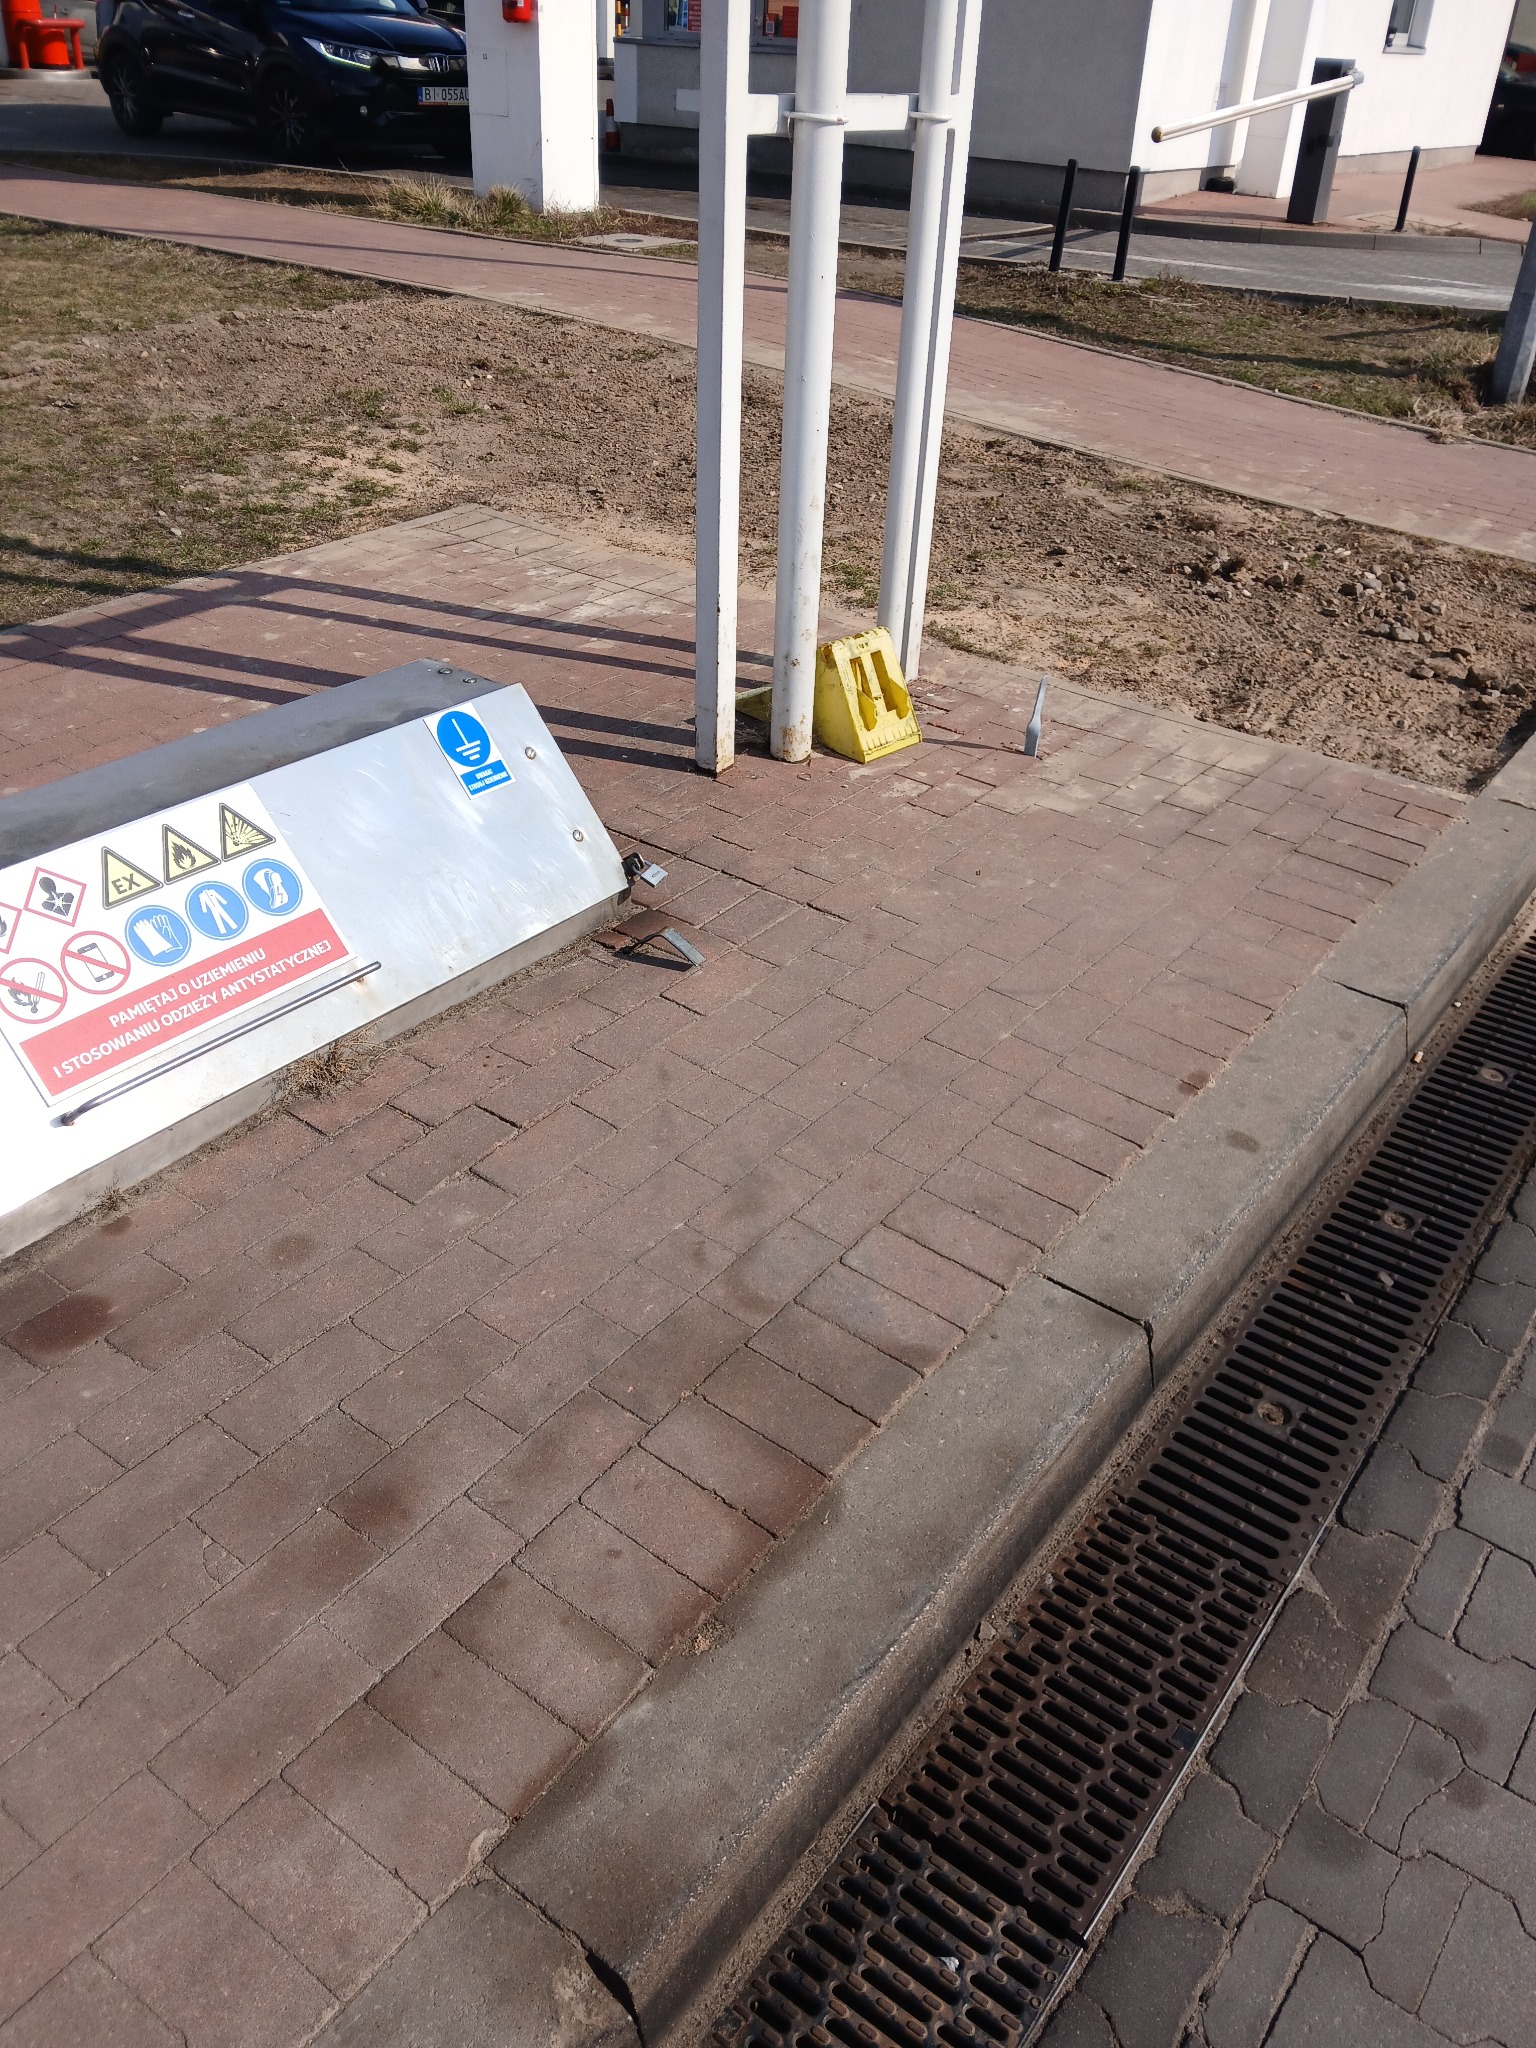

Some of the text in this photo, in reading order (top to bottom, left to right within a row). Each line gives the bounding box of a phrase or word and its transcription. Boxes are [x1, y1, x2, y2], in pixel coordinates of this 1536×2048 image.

[424, 88, 436, 101] BI
[111, 873, 141, 894] EX
[53, 939, 332, 1079] I STOSOWANIU ODZIEŻY ANTYSTATYCZNEJ
[109, 947, 266, 1028] PAMIĘTAJ O UZIEMIENIU
